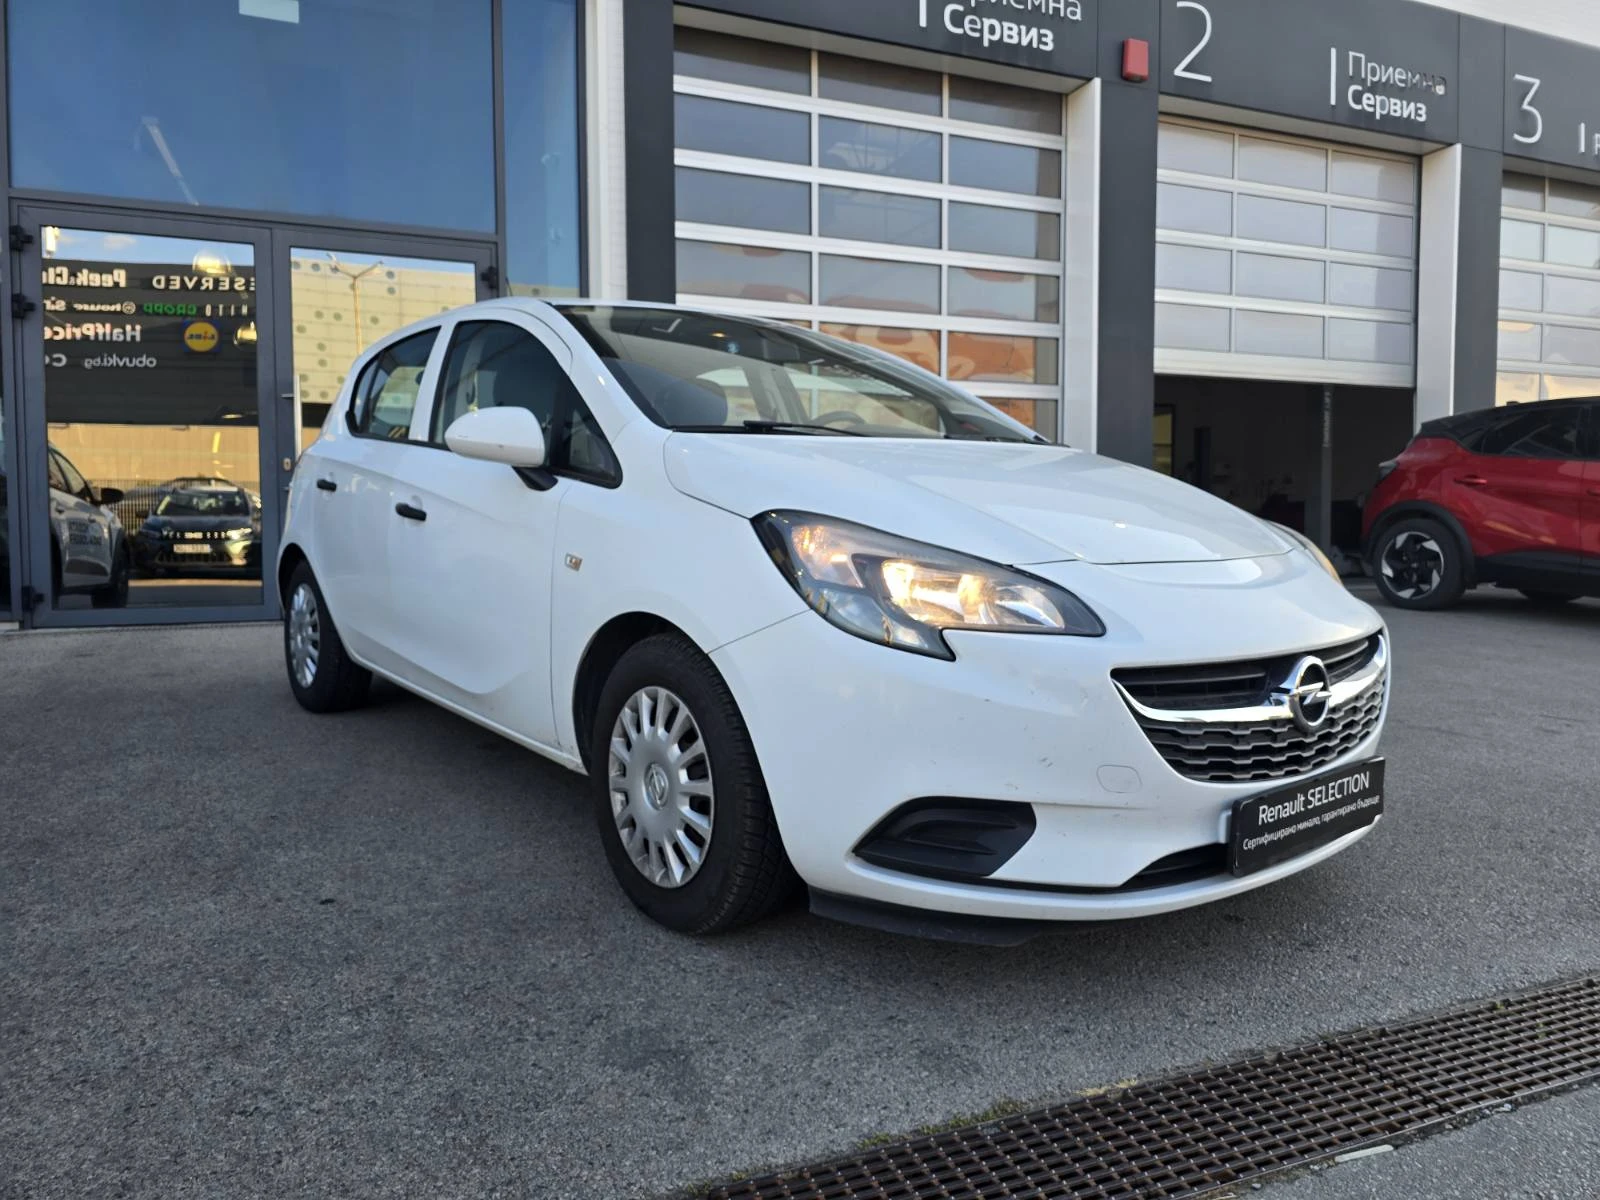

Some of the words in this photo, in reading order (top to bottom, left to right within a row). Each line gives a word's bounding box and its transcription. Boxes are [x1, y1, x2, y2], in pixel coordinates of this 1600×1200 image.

[943, 3, 1055, 52] Сервиз
[1174, 1, 1213, 83] 2
[1347, 84, 1428, 122] Сервиз
[1512, 73, 1544, 144] 3
[1258, 793, 1306, 825] Renault
[1307, 771, 1370, 809] SELECTION
[1242, 823, 1297, 851] Сертифицирано
